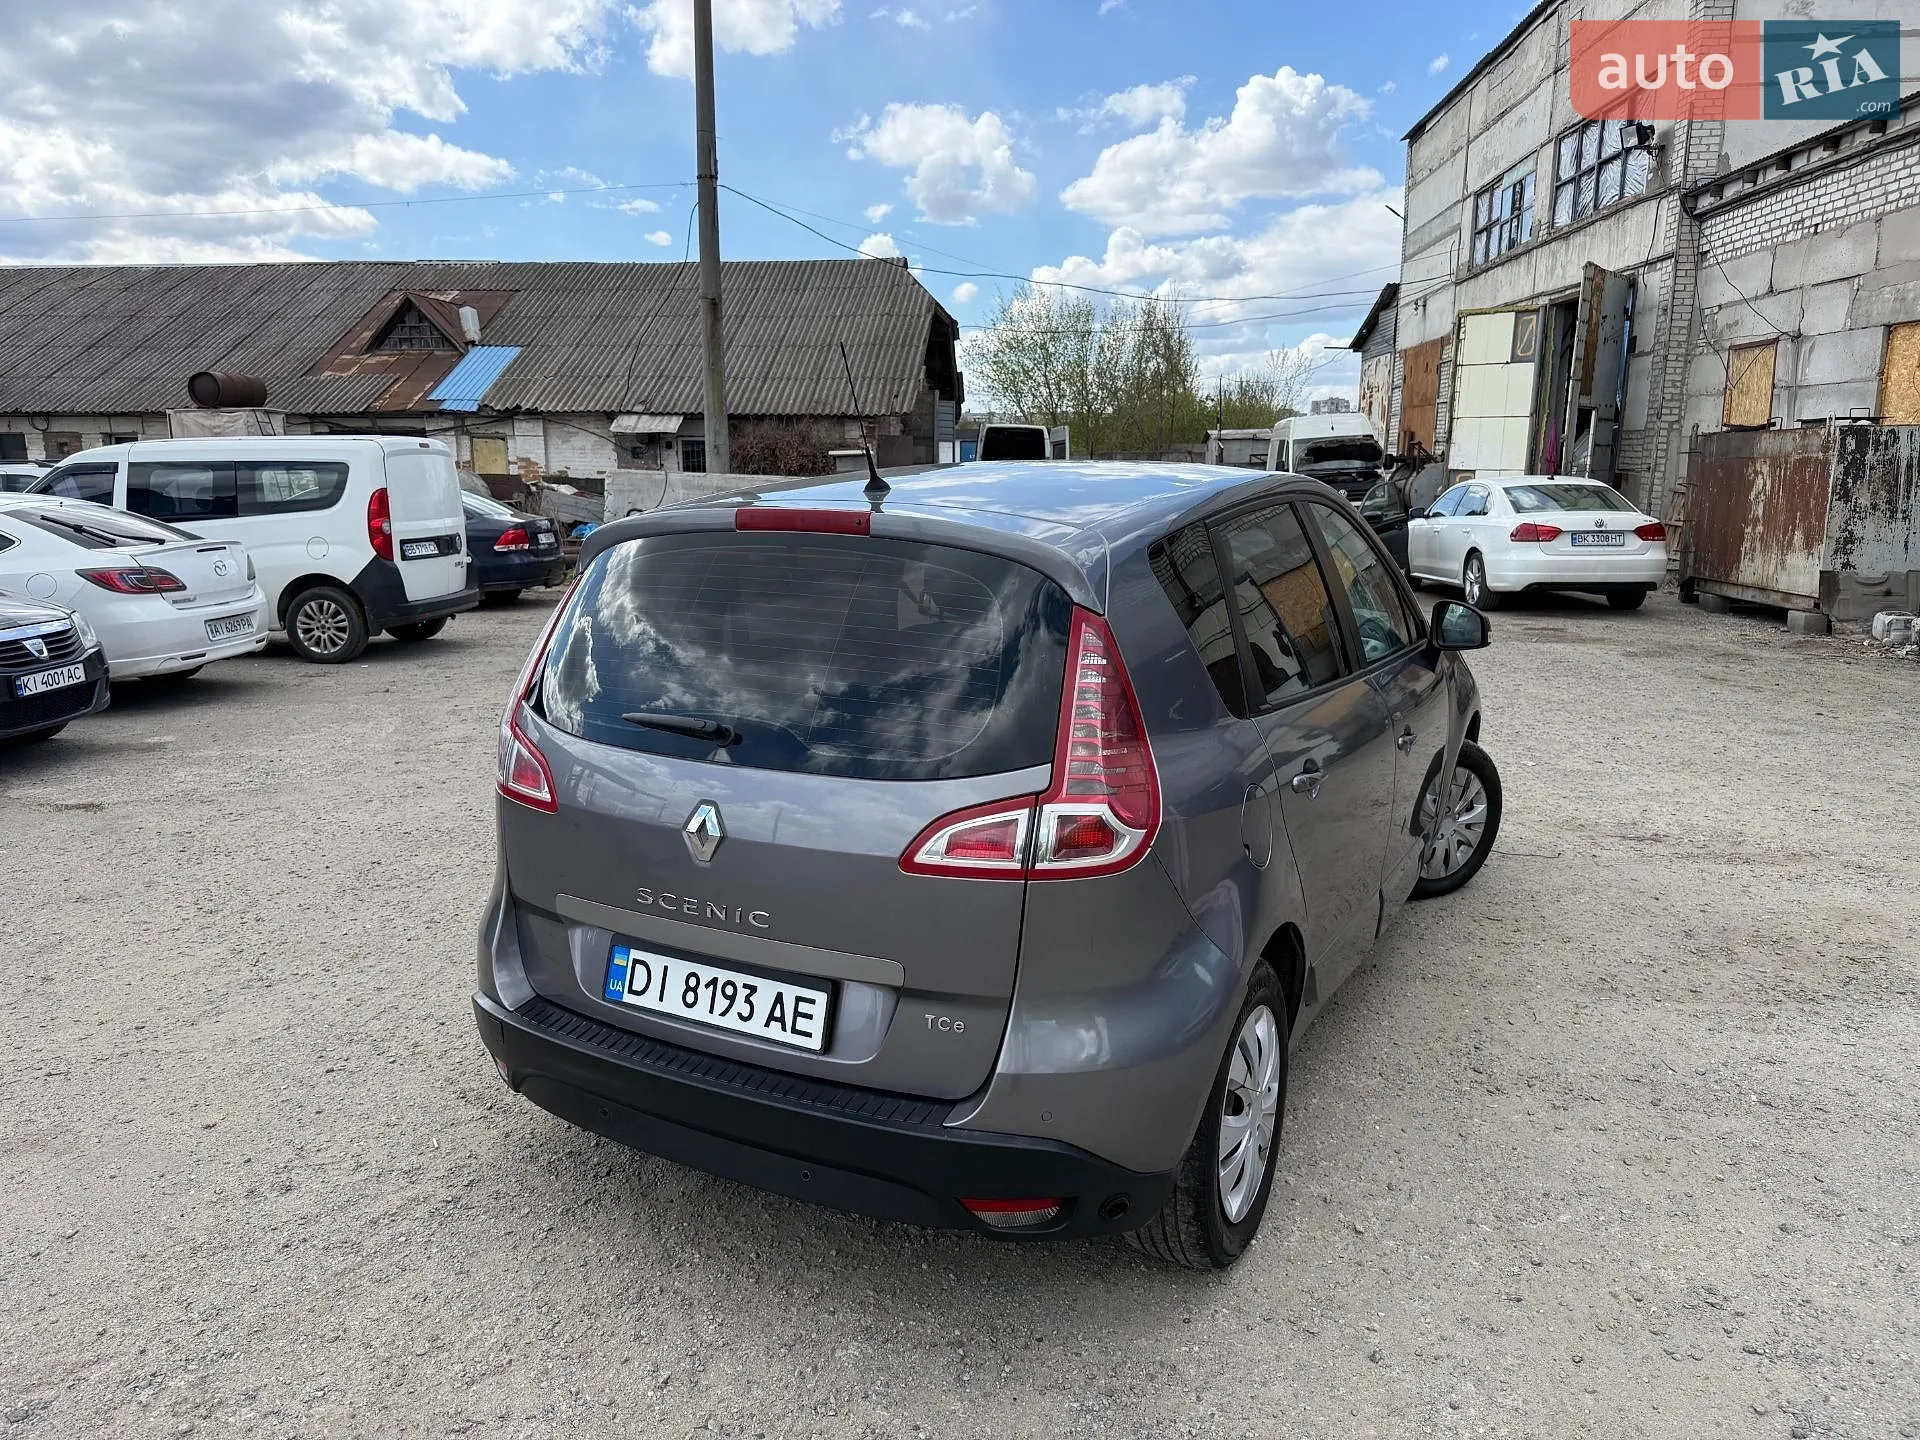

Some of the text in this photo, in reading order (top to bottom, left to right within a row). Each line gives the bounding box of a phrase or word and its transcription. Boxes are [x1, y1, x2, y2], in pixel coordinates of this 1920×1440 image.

[1577, 534, 1591, 543] BK
[213, 622, 225, 637] AI
[22, 676, 38, 693] KI
[41, 669, 66, 689] 4001
[67, 666, 82, 683] AC
[635, 886, 772, 929] SCENIC
[609, 978, 623, 993] UA
[627, 958, 817, 1039] DI 8193 AE
[924, 1013, 966, 1034] TCe
